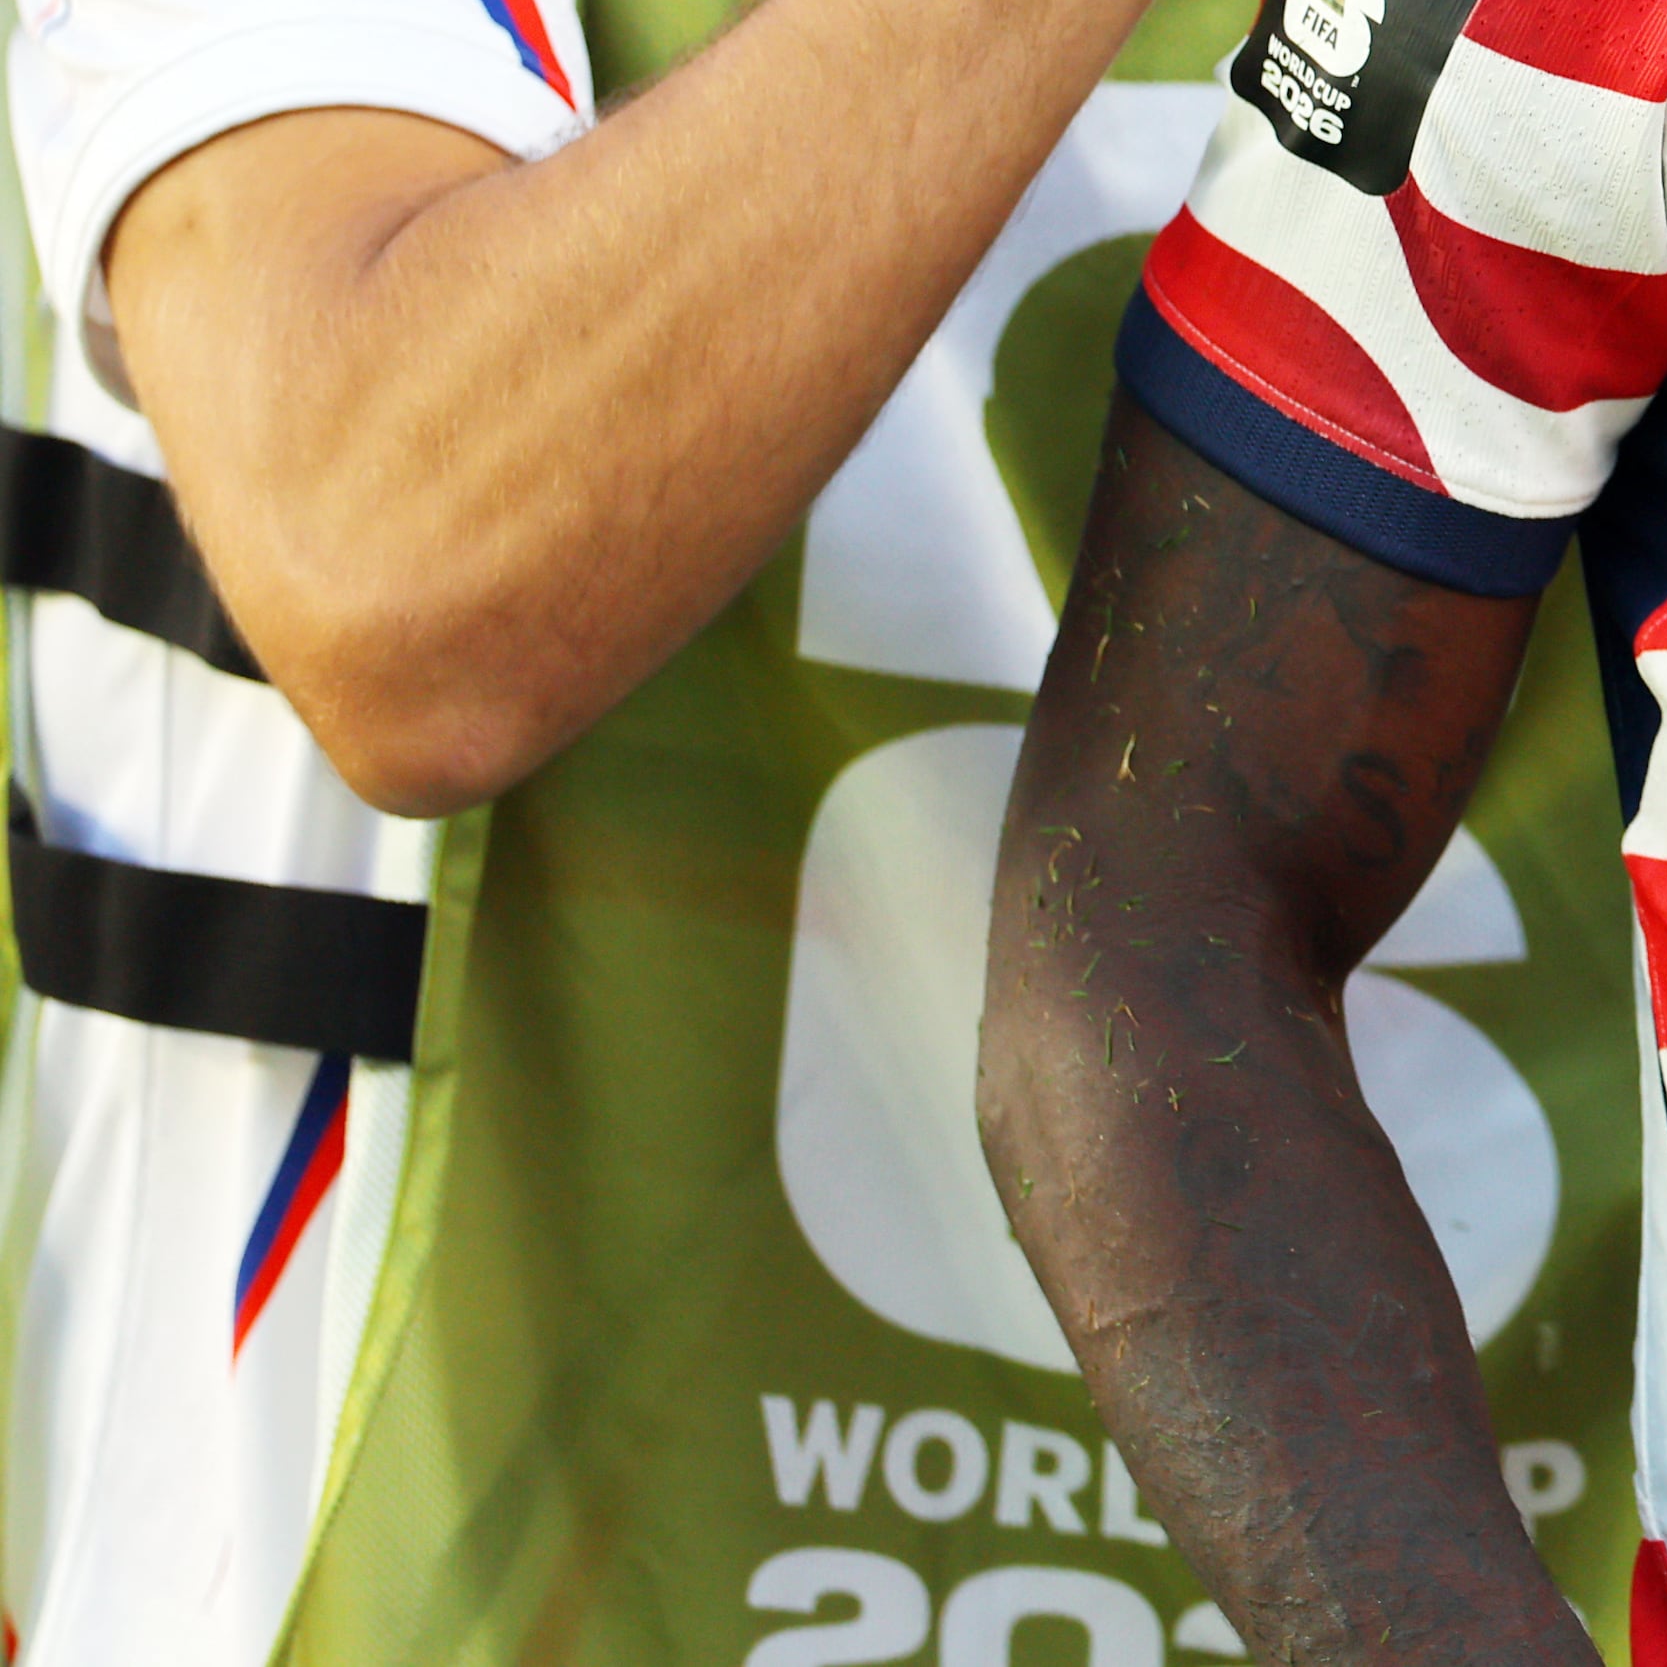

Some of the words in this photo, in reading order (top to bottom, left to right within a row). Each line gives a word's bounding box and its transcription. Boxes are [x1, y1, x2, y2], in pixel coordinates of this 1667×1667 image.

[1301, 4, 1339, 51] FIFA
[1260, 58, 1345, 145] 2026
[1267, 33, 1316, 89] WORLD
[1312, 77, 1352, 112] CUP
[760, 1393, 1170, 1547] WORL
[743, 1546, 1248, 1667] 20
